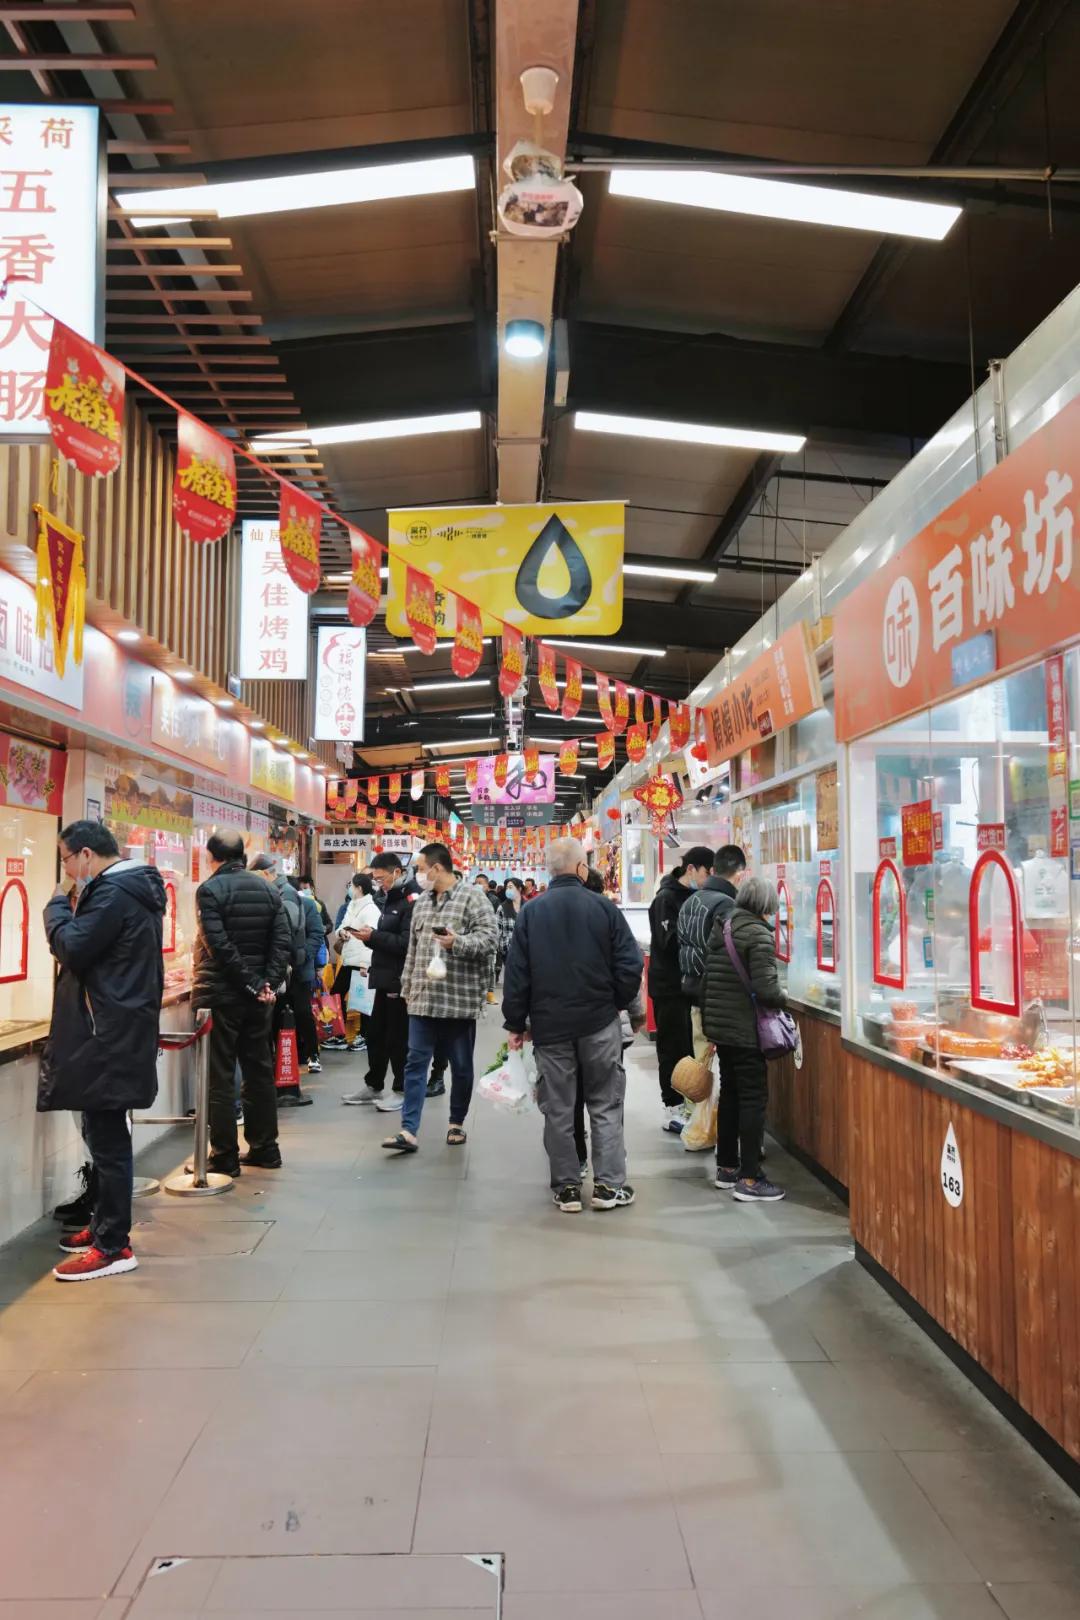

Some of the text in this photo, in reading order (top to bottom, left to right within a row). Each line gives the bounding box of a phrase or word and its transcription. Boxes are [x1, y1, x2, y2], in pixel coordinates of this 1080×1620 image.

[258, 551, 289, 673] 吴佳烤鸡
[928, 470, 1074, 654] 百味坊
[943, 1172, 961, 1197] 163
